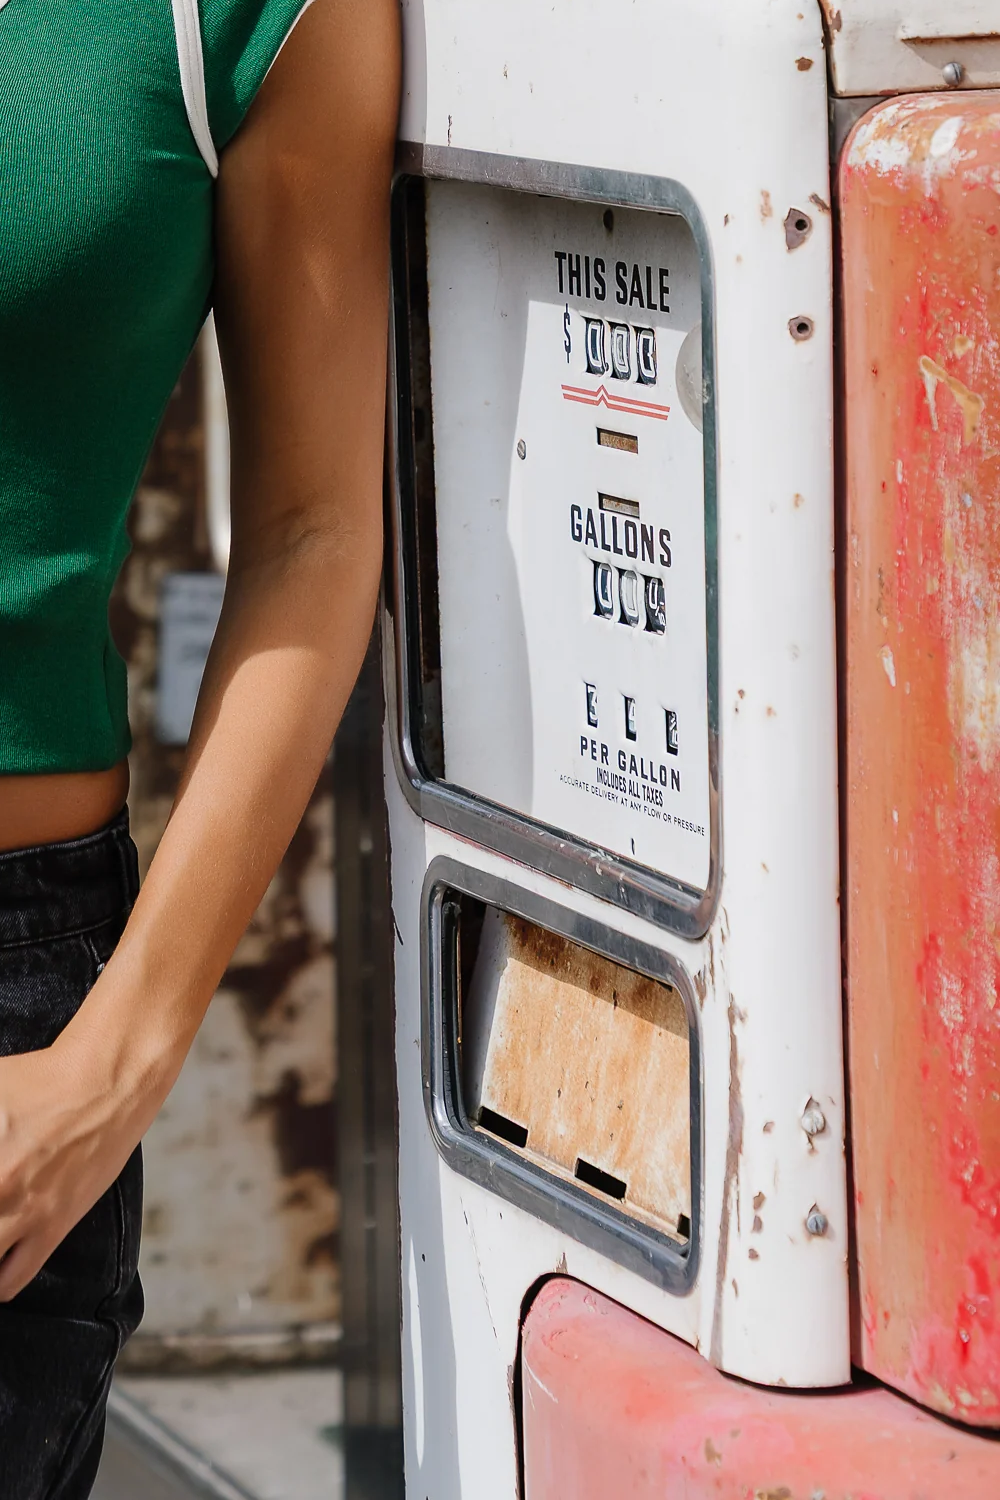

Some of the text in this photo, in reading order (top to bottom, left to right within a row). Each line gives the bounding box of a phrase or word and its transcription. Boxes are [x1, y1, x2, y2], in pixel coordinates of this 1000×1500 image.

[554, 250, 670, 313] THIS SALE
[570, 503, 672, 568] GALLONS
[580, 735, 681, 793] PER GALLON
[596, 766, 664, 808] INCLUDES ALL TAXES
[559, 774, 705, 837] ACCURATE DELIVERY AT ANY FLOW OR PRESSURE
